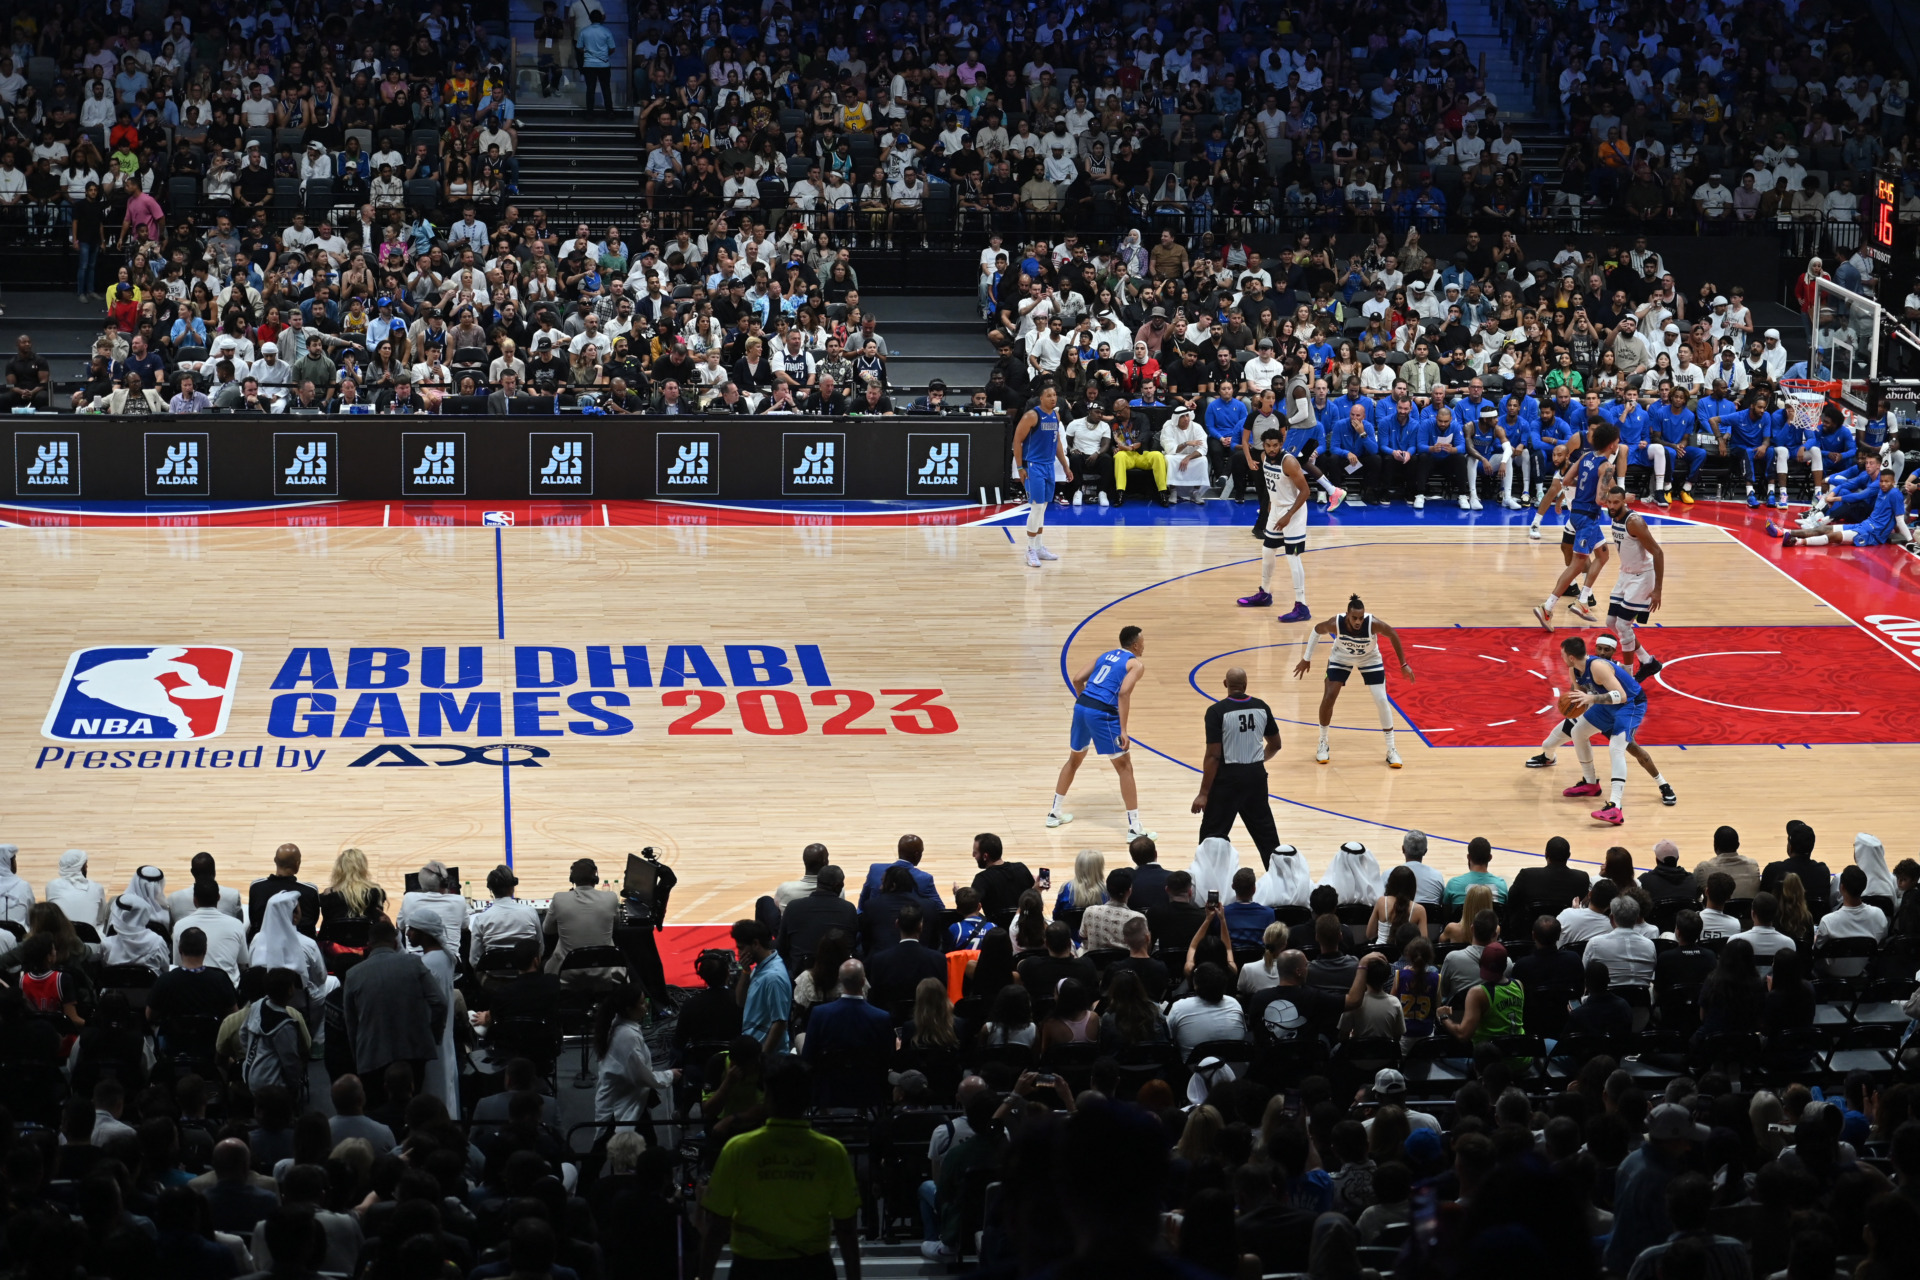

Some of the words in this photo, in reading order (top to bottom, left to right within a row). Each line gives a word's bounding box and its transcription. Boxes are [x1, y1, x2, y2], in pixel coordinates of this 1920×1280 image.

[1878, 203, 1894, 246] 16
[1873, 248, 1892, 265] TISSOT
[1885, 391, 1904, 400] abu
[27, 475, 69, 485] ALDAR
[157, 475, 199, 485] ALDAR
[285, 475, 327, 485] ALDAR
[414, 475, 455, 485] ALDAR
[541, 475, 583, 485] ALDAR
[667, 475, 709, 485] ALDAR
[793, 475, 835, 485] ALDAR
[918, 475, 960, 485] ALDAR
[1265, 478, 1277, 492] 32
[1579, 471, 1588, 491] 2
[269, 647, 483, 689] ABU
[515, 645, 832, 687] DHABI
[1093, 664, 1112, 685] 0
[267, 691, 634, 738] GAMES
[661, 689, 959, 736] 2023
[71, 718, 154, 735] NBA
[1238, 713, 1256, 732] 34
[35, 745, 264, 769] Presented
[276, 745, 326, 772] by
[1400, 994, 1431, 1021] 23
[757, 1170, 817, 1181] SECURITY
